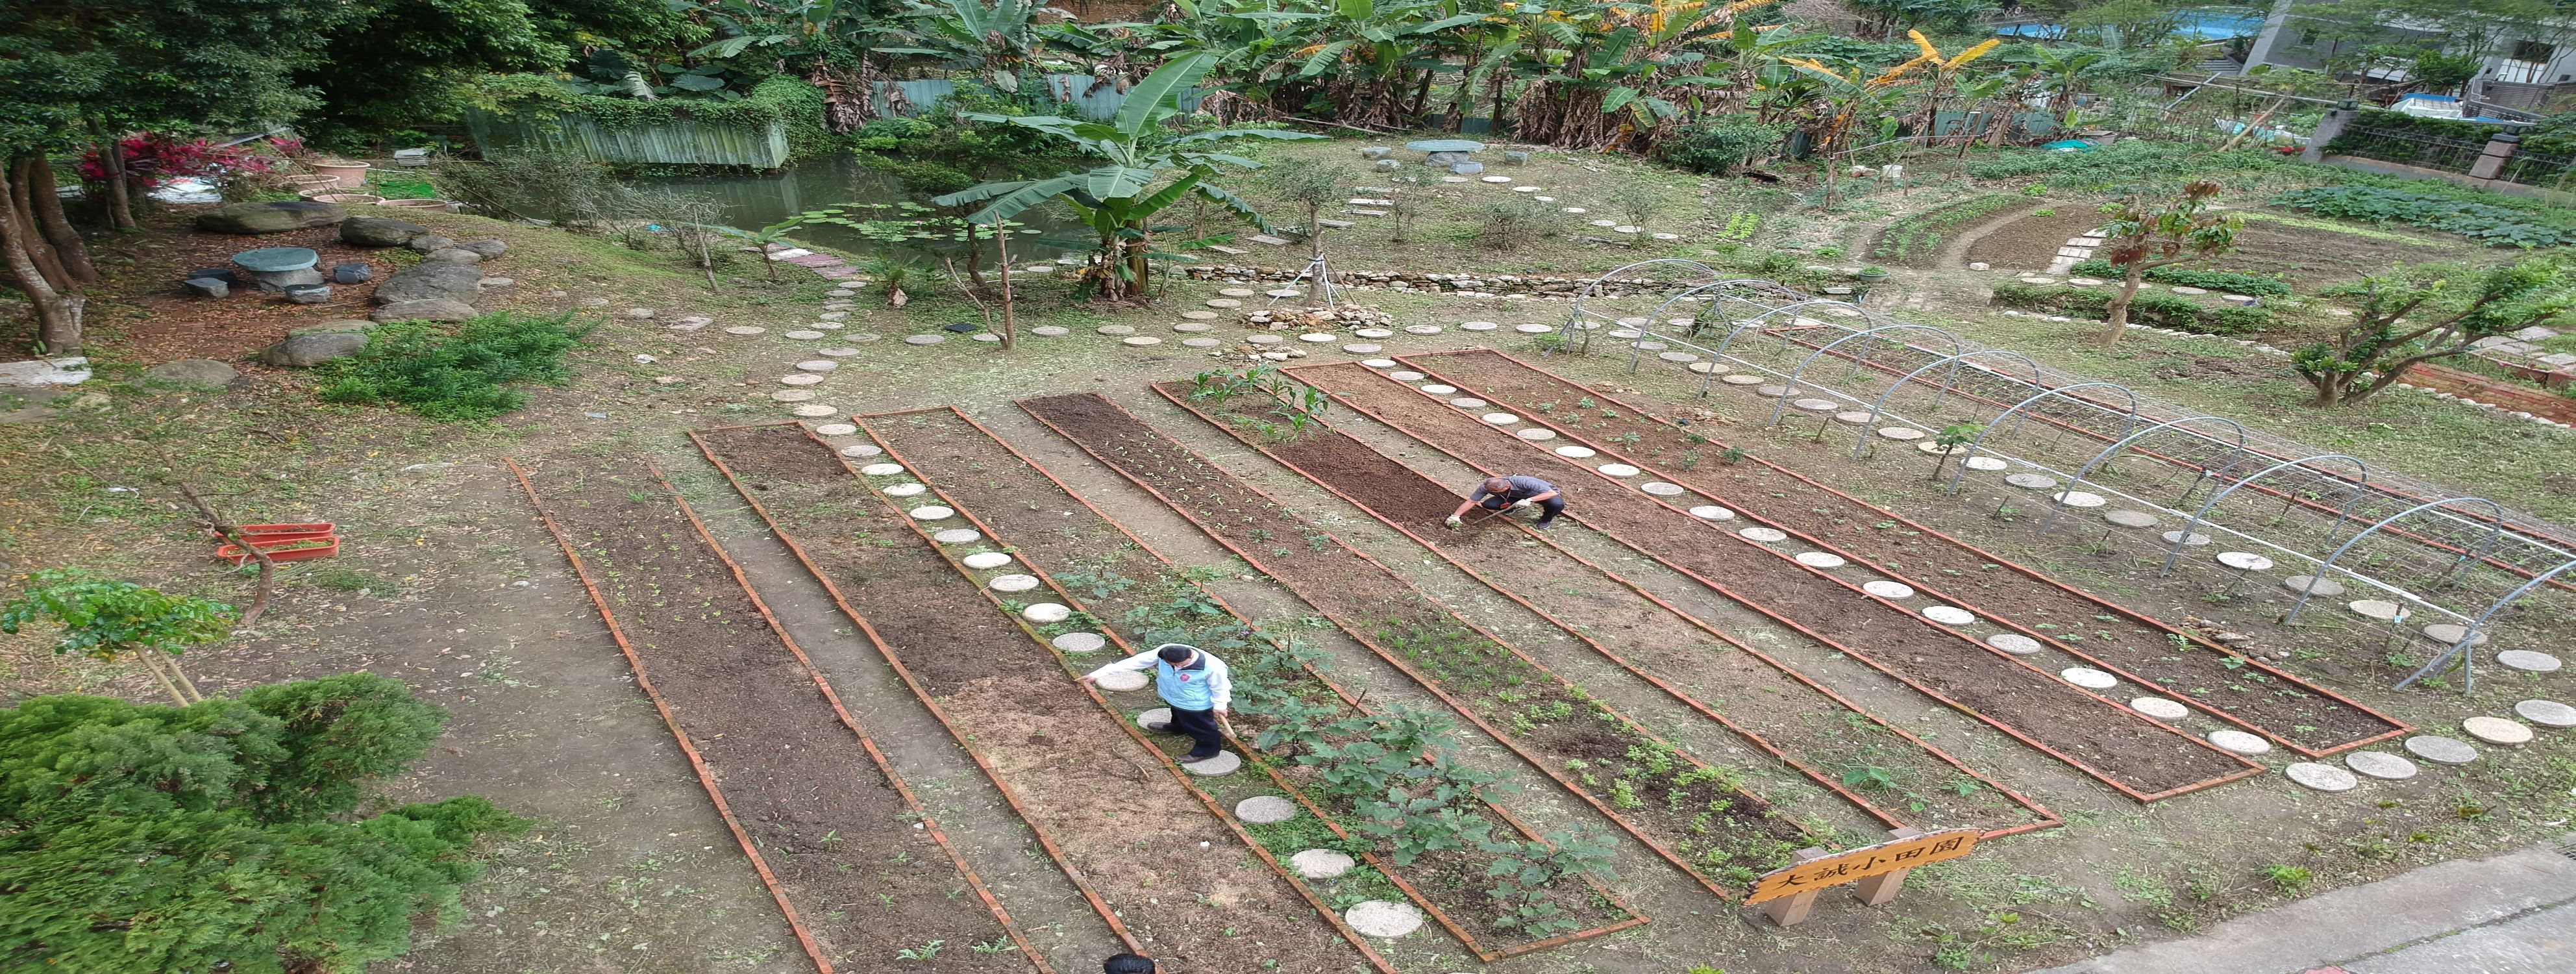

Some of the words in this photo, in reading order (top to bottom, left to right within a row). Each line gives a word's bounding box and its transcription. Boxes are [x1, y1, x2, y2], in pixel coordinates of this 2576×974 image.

[1774, 836, 1964, 890] 大誠小田園
